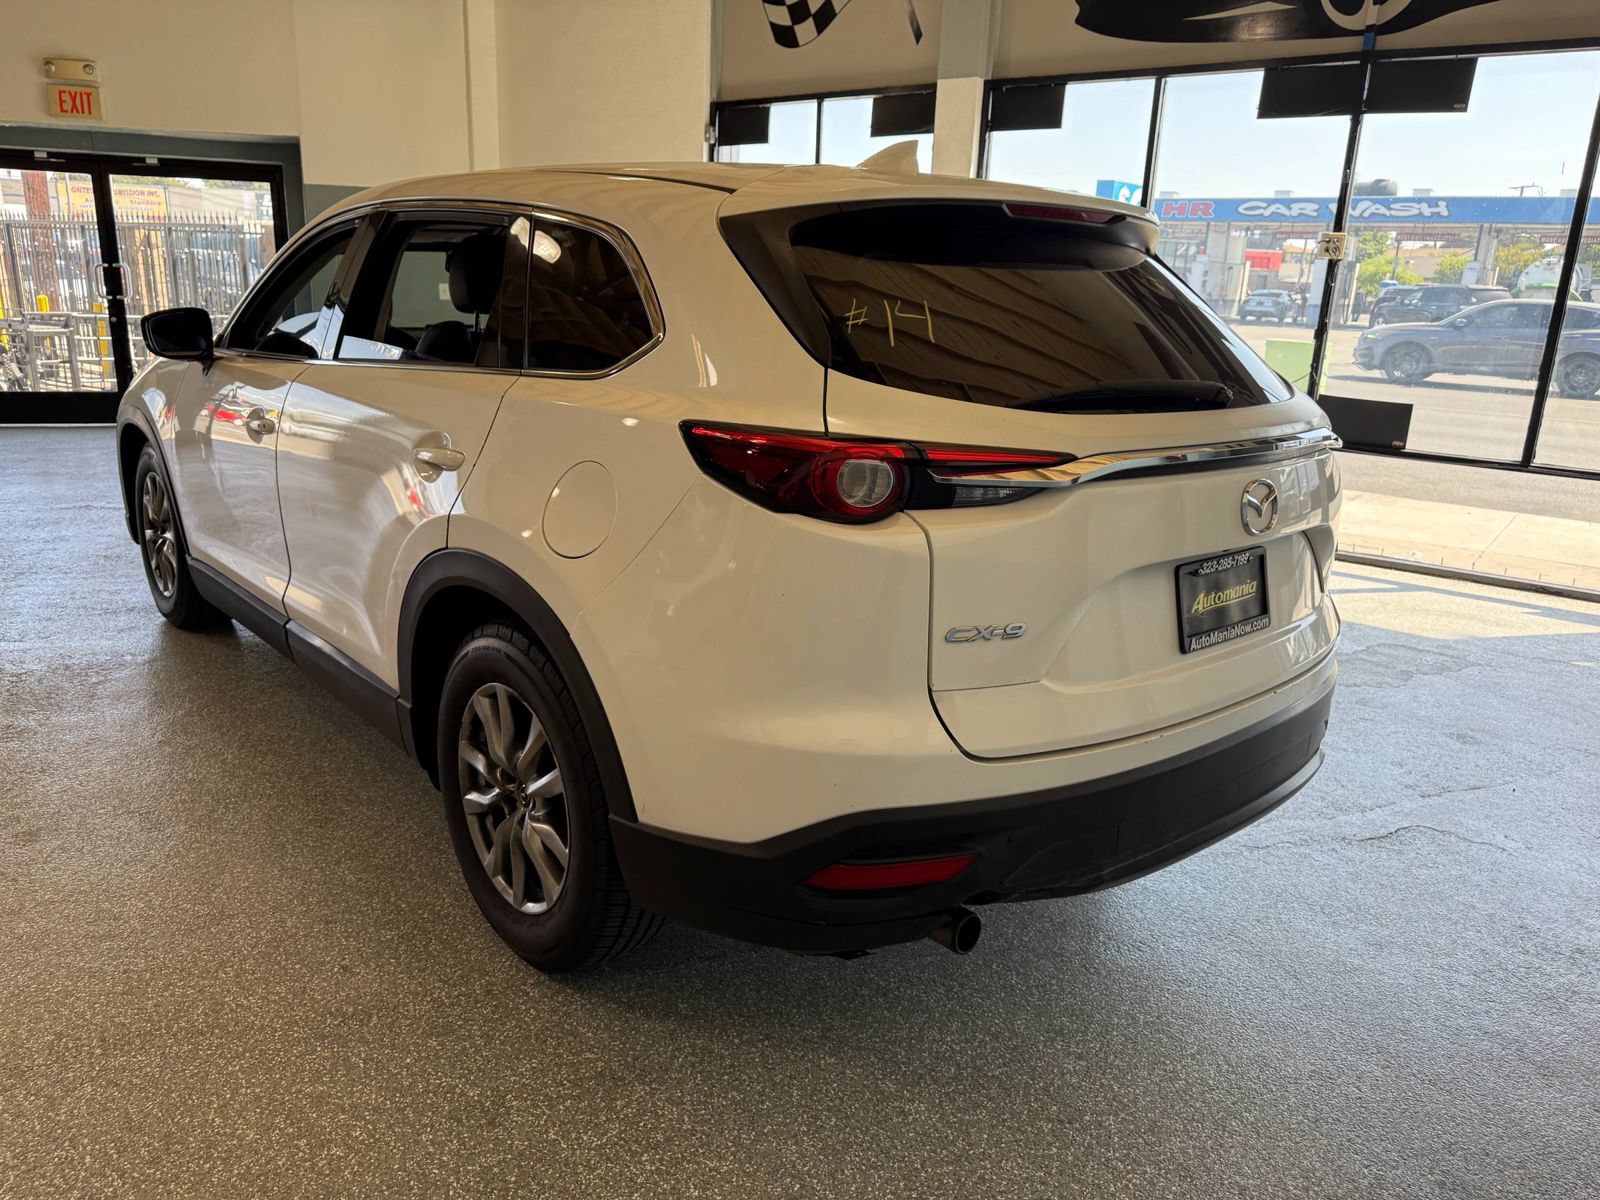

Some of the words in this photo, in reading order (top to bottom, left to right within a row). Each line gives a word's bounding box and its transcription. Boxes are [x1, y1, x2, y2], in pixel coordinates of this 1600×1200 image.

[57, 89, 93, 115] EXIT
[1161, 201, 1215, 218] HR
[1236, 201, 1319, 217] CAR
[1328, 200, 1449, 218] WASH
[1191, 580, 1257, 614] Automania
[944, 622, 1027, 643] CX-9
[1190, 617, 1270, 652] AutoManiaNow.com
